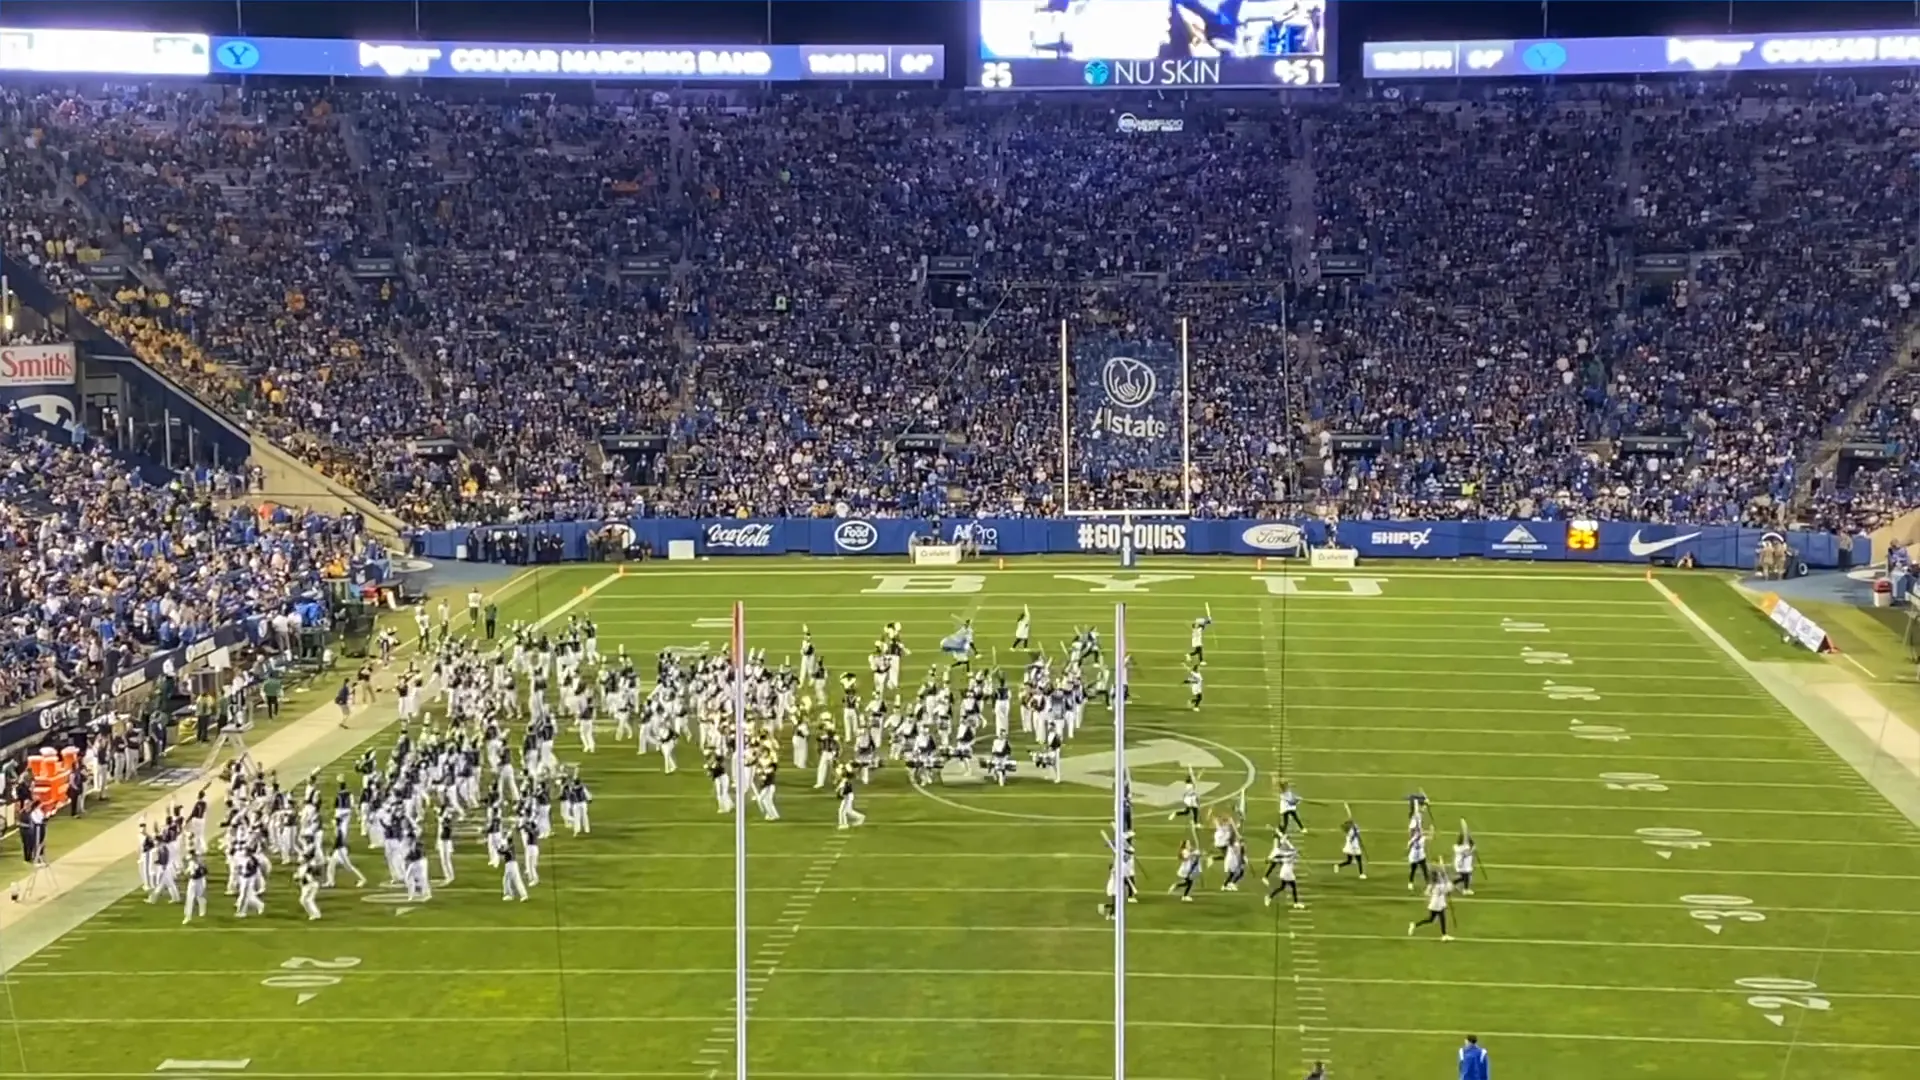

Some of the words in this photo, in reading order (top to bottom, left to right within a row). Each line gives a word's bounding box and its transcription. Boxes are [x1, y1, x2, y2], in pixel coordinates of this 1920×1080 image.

[450, 49, 558, 71] COUGAR
[561, 50, 695, 72] MARCHING
[698, 51, 771, 73] BAND
[1763, 38, 1876, 62] COUGAR
[981, 62, 1012, 88] 25
[1115, 61, 1154, 84] NU
[1160, 60, 1220, 84] SKIN
[1, 350, 73, 378] Smith's
[1091, 406, 1166, 438] Allstate
[707, 523, 774, 547] Coca-Cola
[1256, 529, 1296, 545] Ford
[1371, 528, 1432, 549] SHIPEX
[1567, 529, 1596, 549] 25
[1679, 894, 1767, 922] 30
[261, 956, 362, 987] 20
[1734, 977, 1832, 1010] 20
